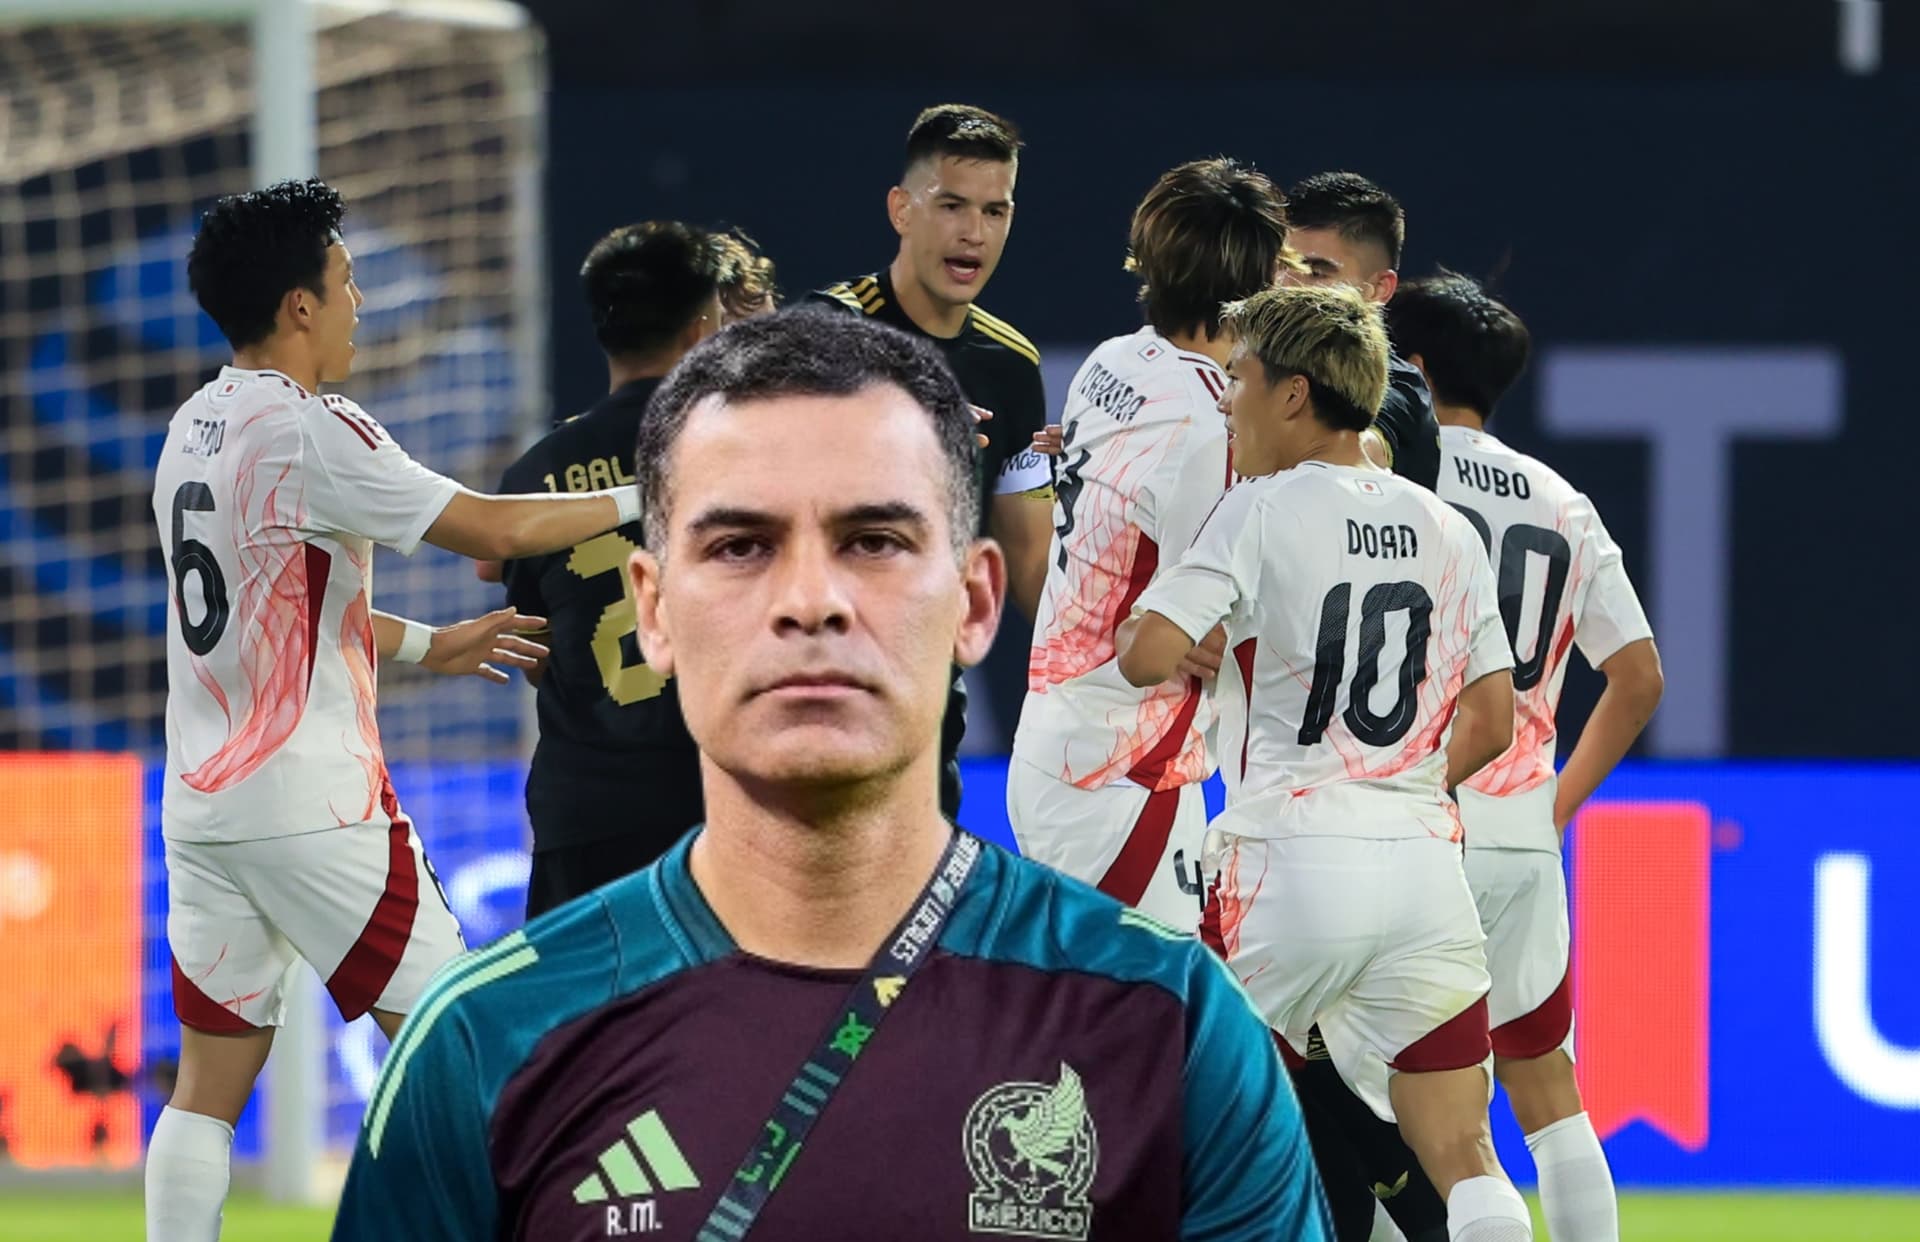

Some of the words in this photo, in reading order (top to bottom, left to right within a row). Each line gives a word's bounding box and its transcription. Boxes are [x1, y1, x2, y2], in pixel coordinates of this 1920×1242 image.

[565, 455, 638, 492] GAL
[1454, 455, 1531, 499] KUBO
[1346, 518, 1418, 559] DOAN
[171, 481, 229, 656] 6
[1298, 581, 1434, 747] 10
[1173, 851, 1206, 912] 4
